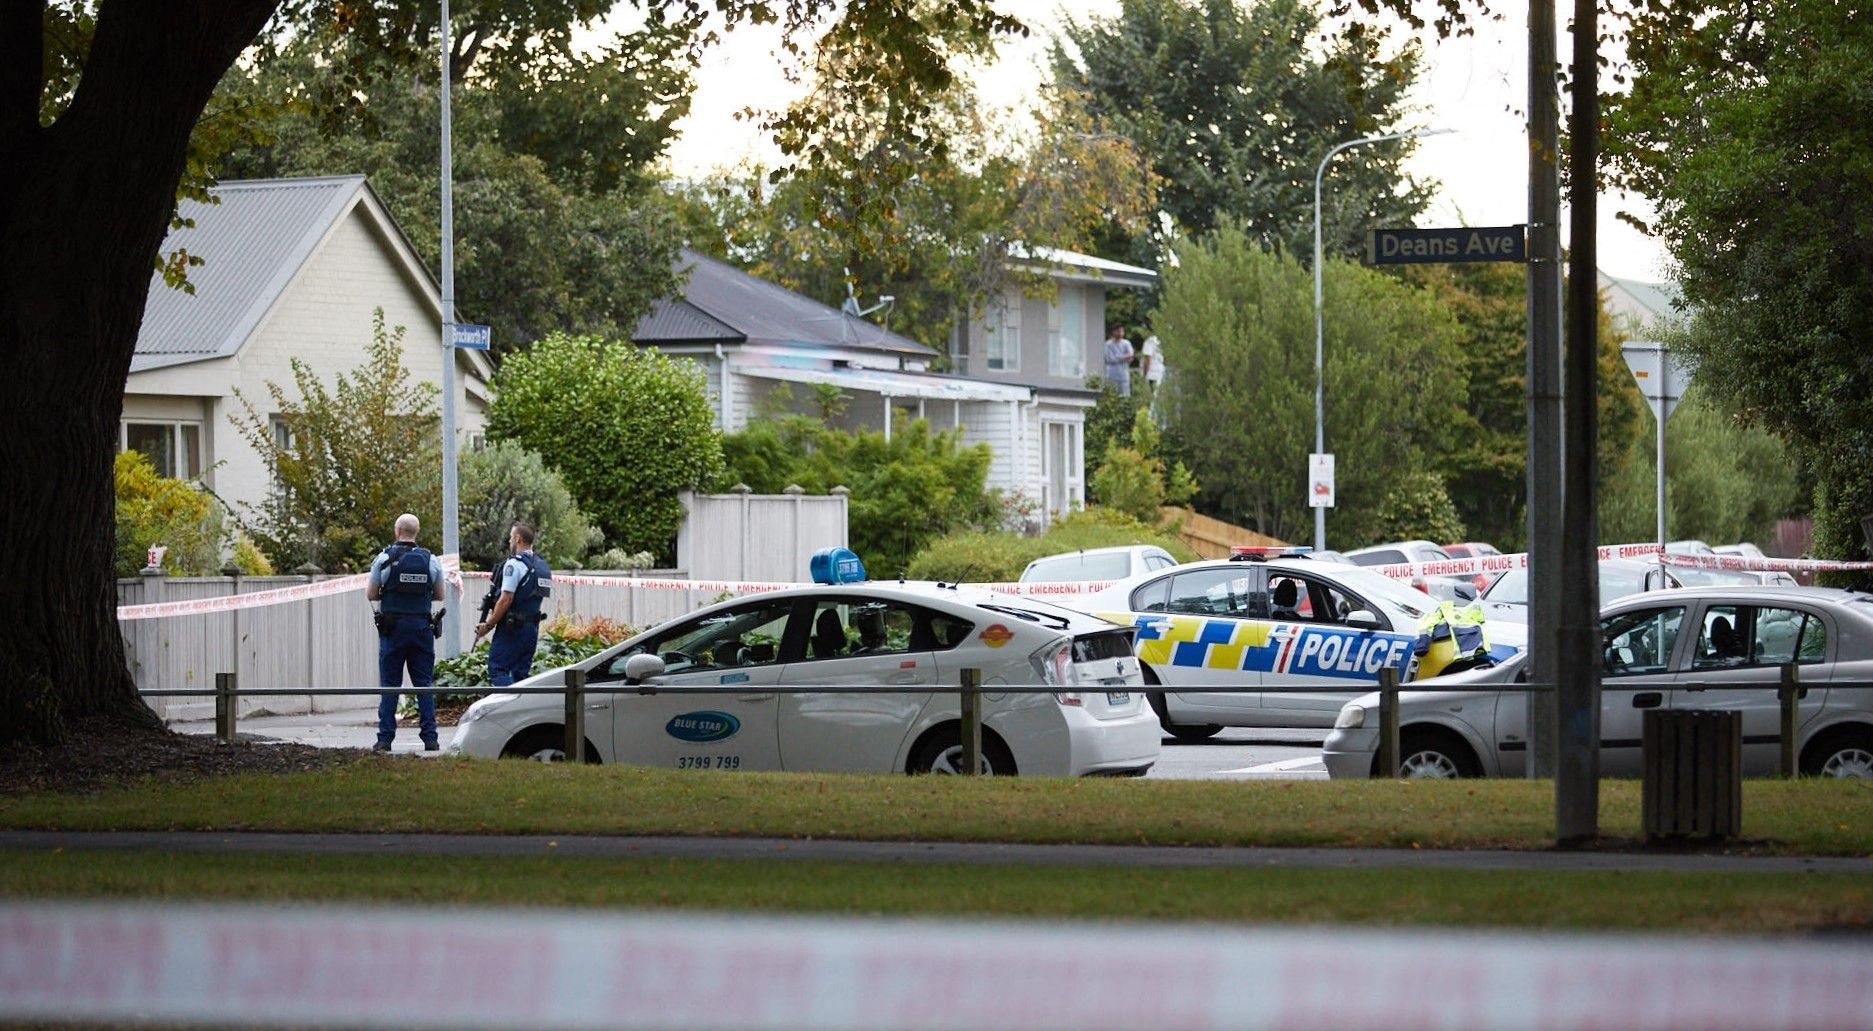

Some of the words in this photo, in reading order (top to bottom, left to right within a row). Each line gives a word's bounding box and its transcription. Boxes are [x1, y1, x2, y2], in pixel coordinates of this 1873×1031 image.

[1382, 233, 1458, 257] Deans
[1466, 231, 1515, 255] Ave
[1383, 565, 1415, 578] POLICE
[1422, 560, 1475, 576] EMERGENCY
[1482, 557, 1513, 570] POLICE
[1297, 633, 1409, 674] POLICE
[674, 718, 697, 729] BLUE
[699, 721, 721, 731] STAR
[679, 756, 711, 769] 3799
[716, 755, 740, 769] 799
